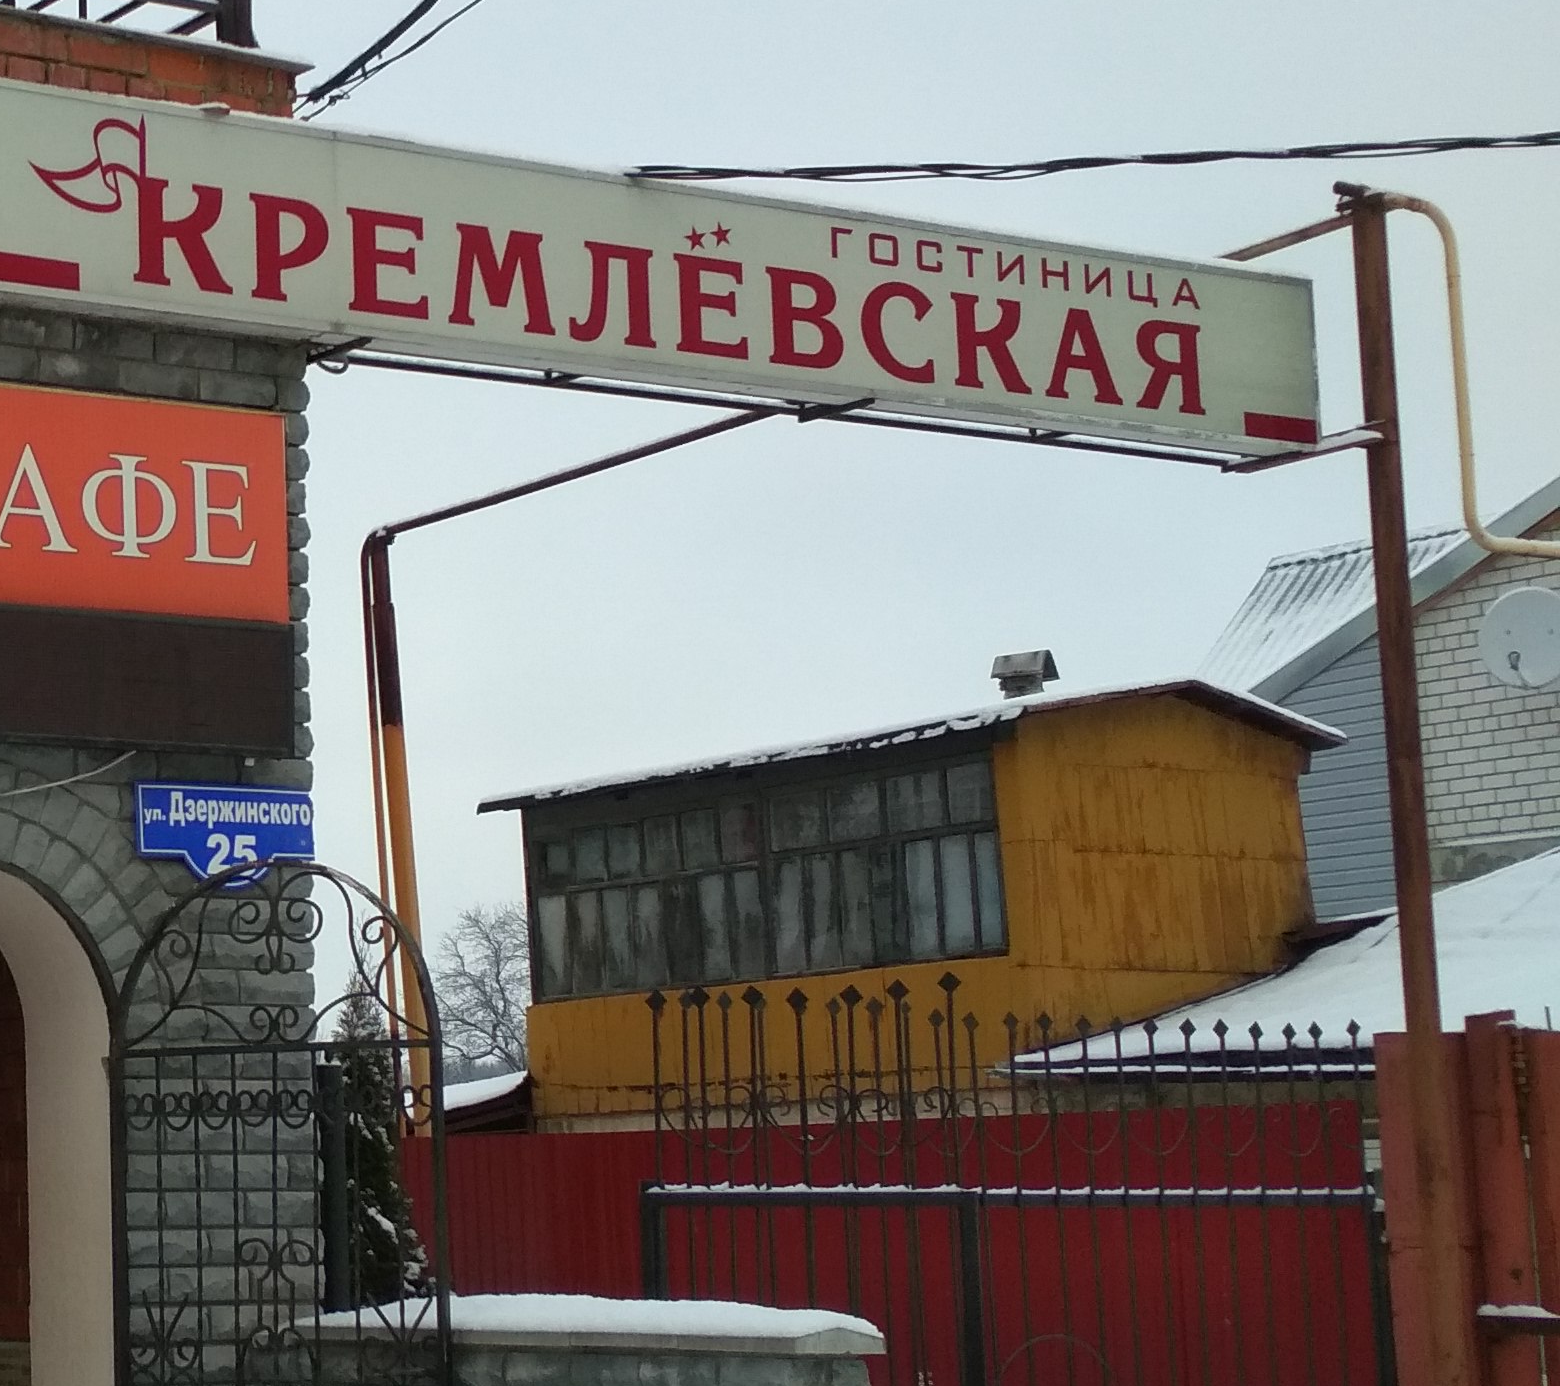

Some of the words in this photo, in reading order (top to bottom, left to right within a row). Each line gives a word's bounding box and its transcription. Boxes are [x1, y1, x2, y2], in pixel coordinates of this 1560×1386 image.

[829, 225, 1202, 311] ГОСТИНИЦА
[143, 807, 167, 825] ул.
[168, 790, 312, 830] Дзержинского
[205, 832, 259, 877] 25
